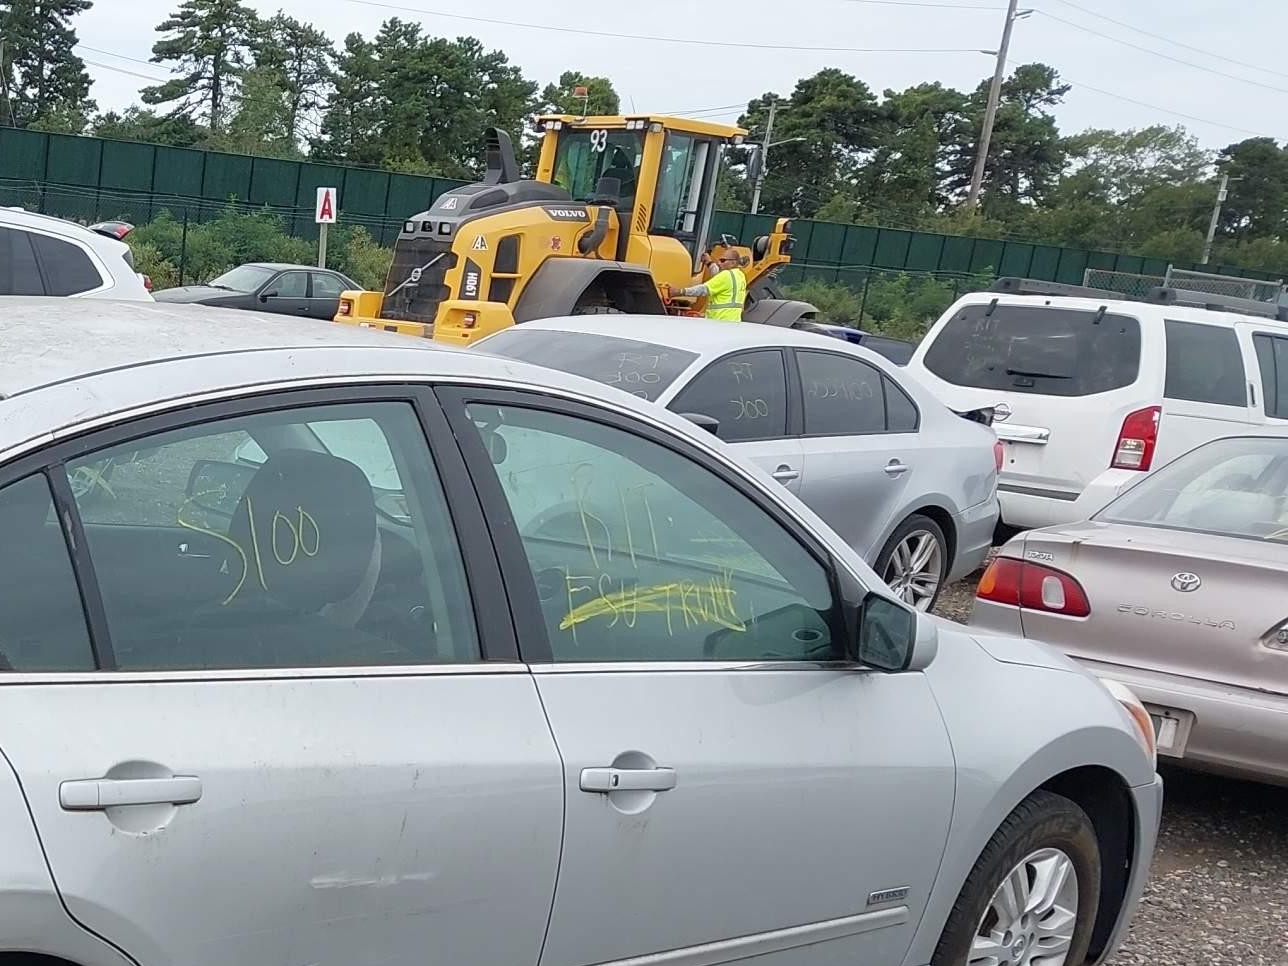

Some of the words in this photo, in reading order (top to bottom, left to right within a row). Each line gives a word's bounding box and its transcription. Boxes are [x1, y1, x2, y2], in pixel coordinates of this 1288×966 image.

[590, 129, 608, 153] 93
[319, 188, 333, 219] A
[548, 209, 587, 219] VOLVO
[464, 271, 479, 297] L90H
[1116, 603, 1236, 630] COROLLA
